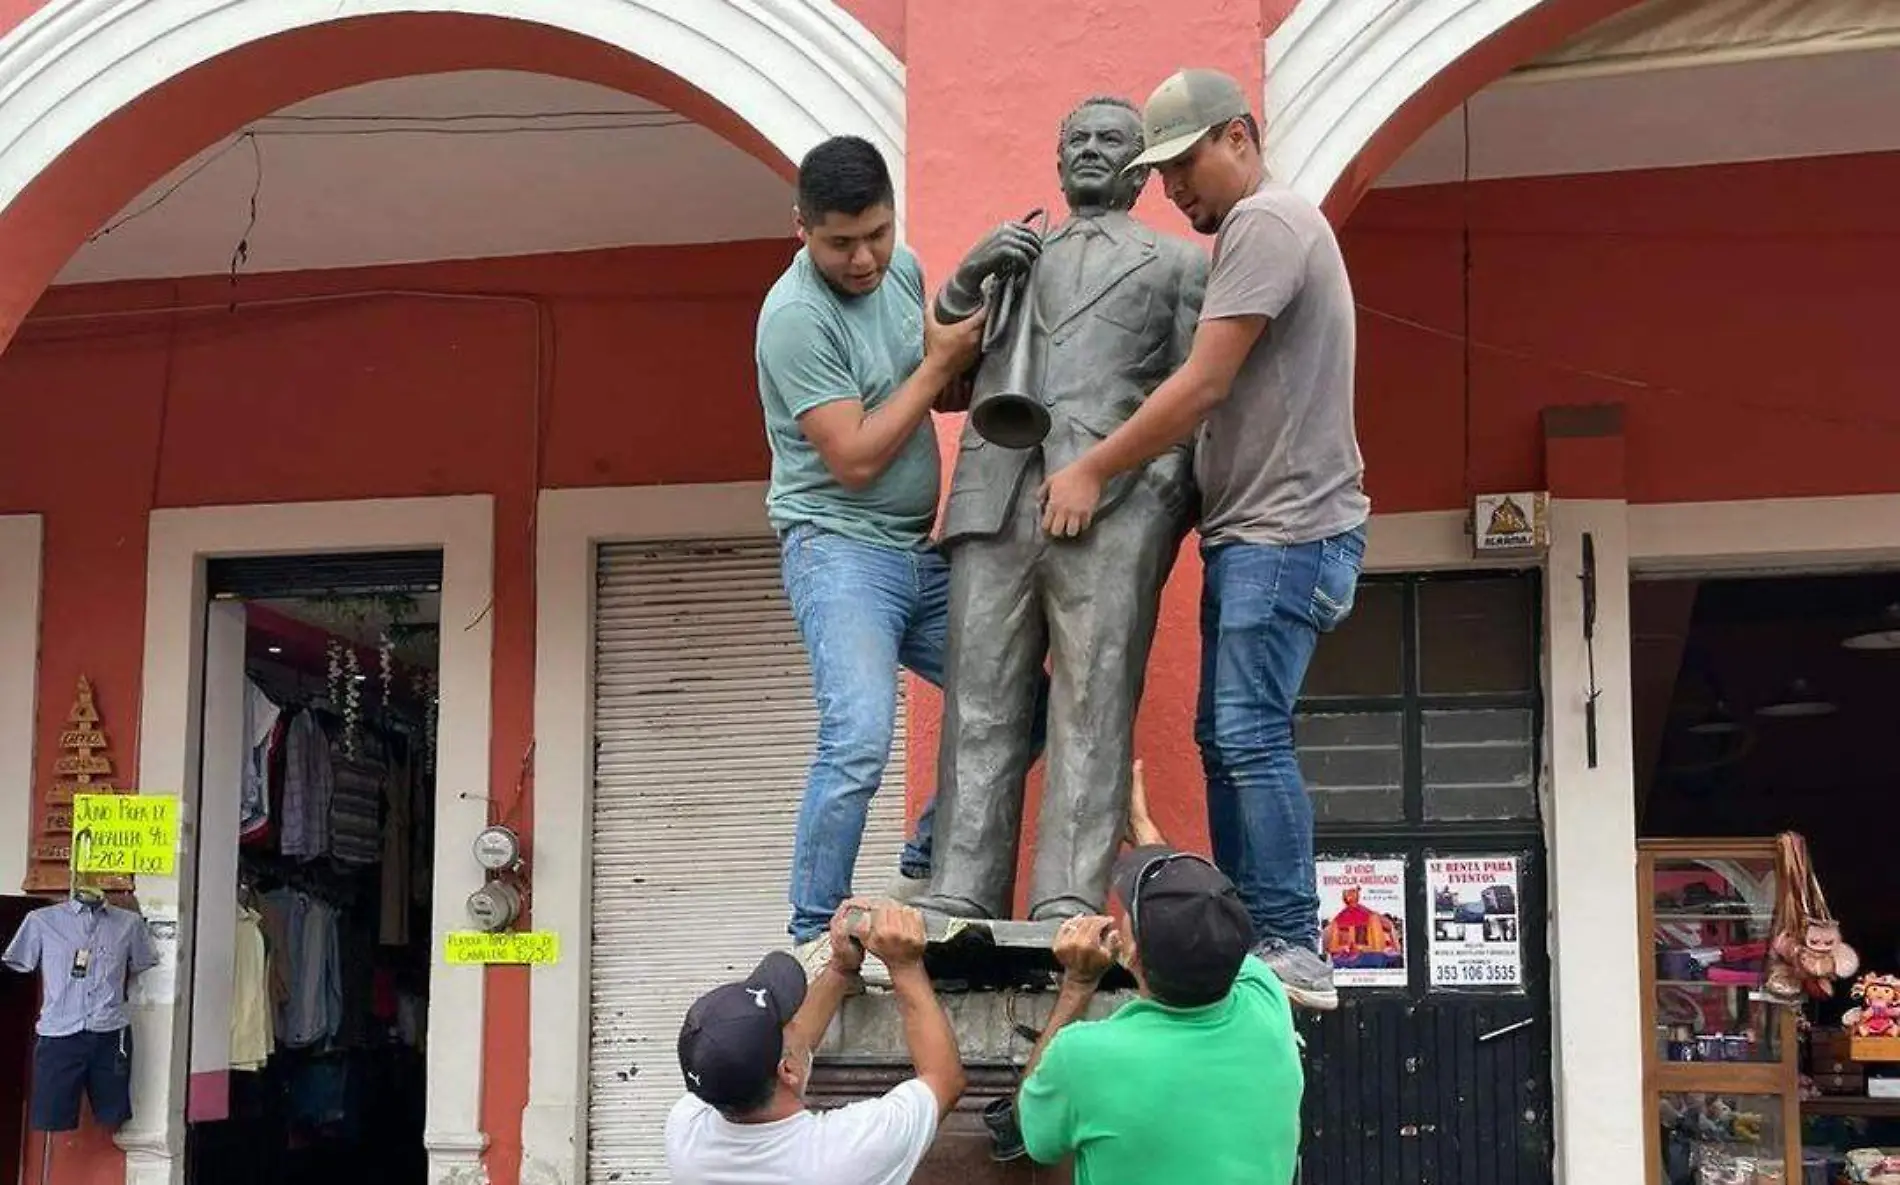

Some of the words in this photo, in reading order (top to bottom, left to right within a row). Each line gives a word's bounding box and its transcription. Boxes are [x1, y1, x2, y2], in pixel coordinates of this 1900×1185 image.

[1431, 862, 1441, 873] SE
[1446, 861, 1480, 873] RENTA
[1484, 861, 1512, 872] PARA
[1449, 873, 1496, 884] EVENTOS
[1437, 965, 1457, 980] 353
[1462, 965, 1483, 980] 106
[1486, 964, 1516, 980] 3535
